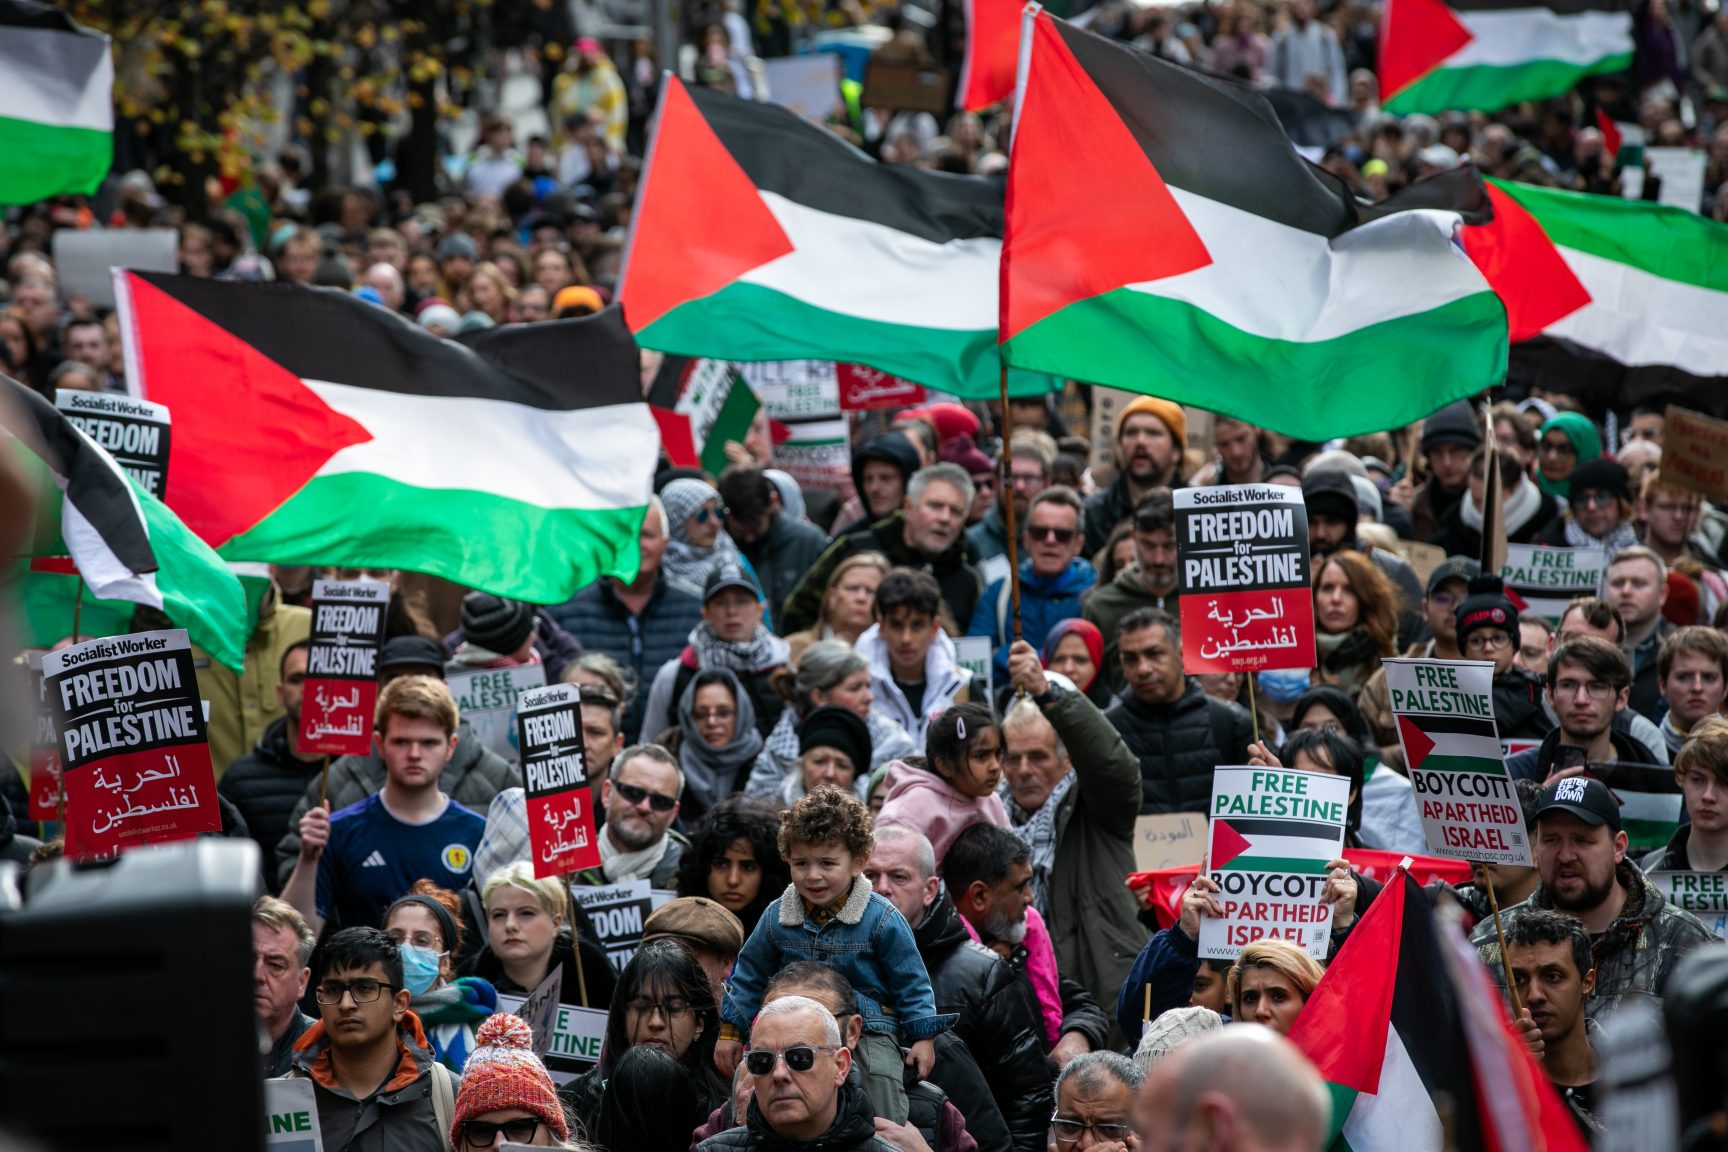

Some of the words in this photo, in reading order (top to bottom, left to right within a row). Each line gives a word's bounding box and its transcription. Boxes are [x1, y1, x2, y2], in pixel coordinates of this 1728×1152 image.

[71, 395, 116, 412] Socialist
[117, 401, 154, 418] Worker
[1193, 491, 1243, 505] Socialist
[1244, 489, 1285, 501] Worker
[1187, 508, 1294, 543] FREEDOM
[1232, 540, 1252, 555] for
[1531, 550, 1575, 568] FREE
[1185, 552, 1303, 588] PALESTINE
[1500, 565, 1599, 586] PALESTINE
[323, 585, 351, 597] Socialist
[352, 586, 378, 598] Worker
[315, 604, 380, 635] FREEDOM
[1207, 596, 1284, 628] الحرية
[61, 643, 117, 668] Socialist
[117, 636, 167, 654] Worker
[336, 632, 350, 646] for
[1200, 625, 1297, 659] لفلسطين
[309, 646, 378, 676] PALESTINE
[59, 657, 181, 711] FREEDOM
[470, 670, 512, 692] FREE
[1415, 665, 1459, 689] FREE
[113, 699, 134, 714] for
[315, 685, 360, 713] الحرية
[523, 692, 548, 708] Socialist
[548, 690, 569, 704] Worker
[1391, 689, 1491, 717] PALESTINE
[64, 705, 198, 761] PALESTINE
[306, 713, 364, 740] لفلسطين
[523, 709, 577, 748] FREEDOM
[550, 742, 560, 757] for
[92, 754, 181, 794] الحرية
[525, 752, 586, 793] PALESTINE
[1251, 772, 1309, 795] FREE
[1412, 770, 1511, 799] BOYCOTT
[1559, 777, 1589, 788] SYSTEM
[92, 784, 200, 834] لفلسطين
[1215, 795, 1343, 822] PALESTINE
[1554, 790, 1585, 803] DOWN
[543, 797, 581, 830] الحرية
[1423, 800, 1518, 825] APARTHEID
[542, 825, 589, 863] لفلسطين
[1441, 825, 1509, 851] ISRAEL
[1434, 847, 1526, 862] www.scottishpsc.org.uk
[1671, 874, 1725, 892] FREE
[1227, 925, 1307, 948] ISRAEL
